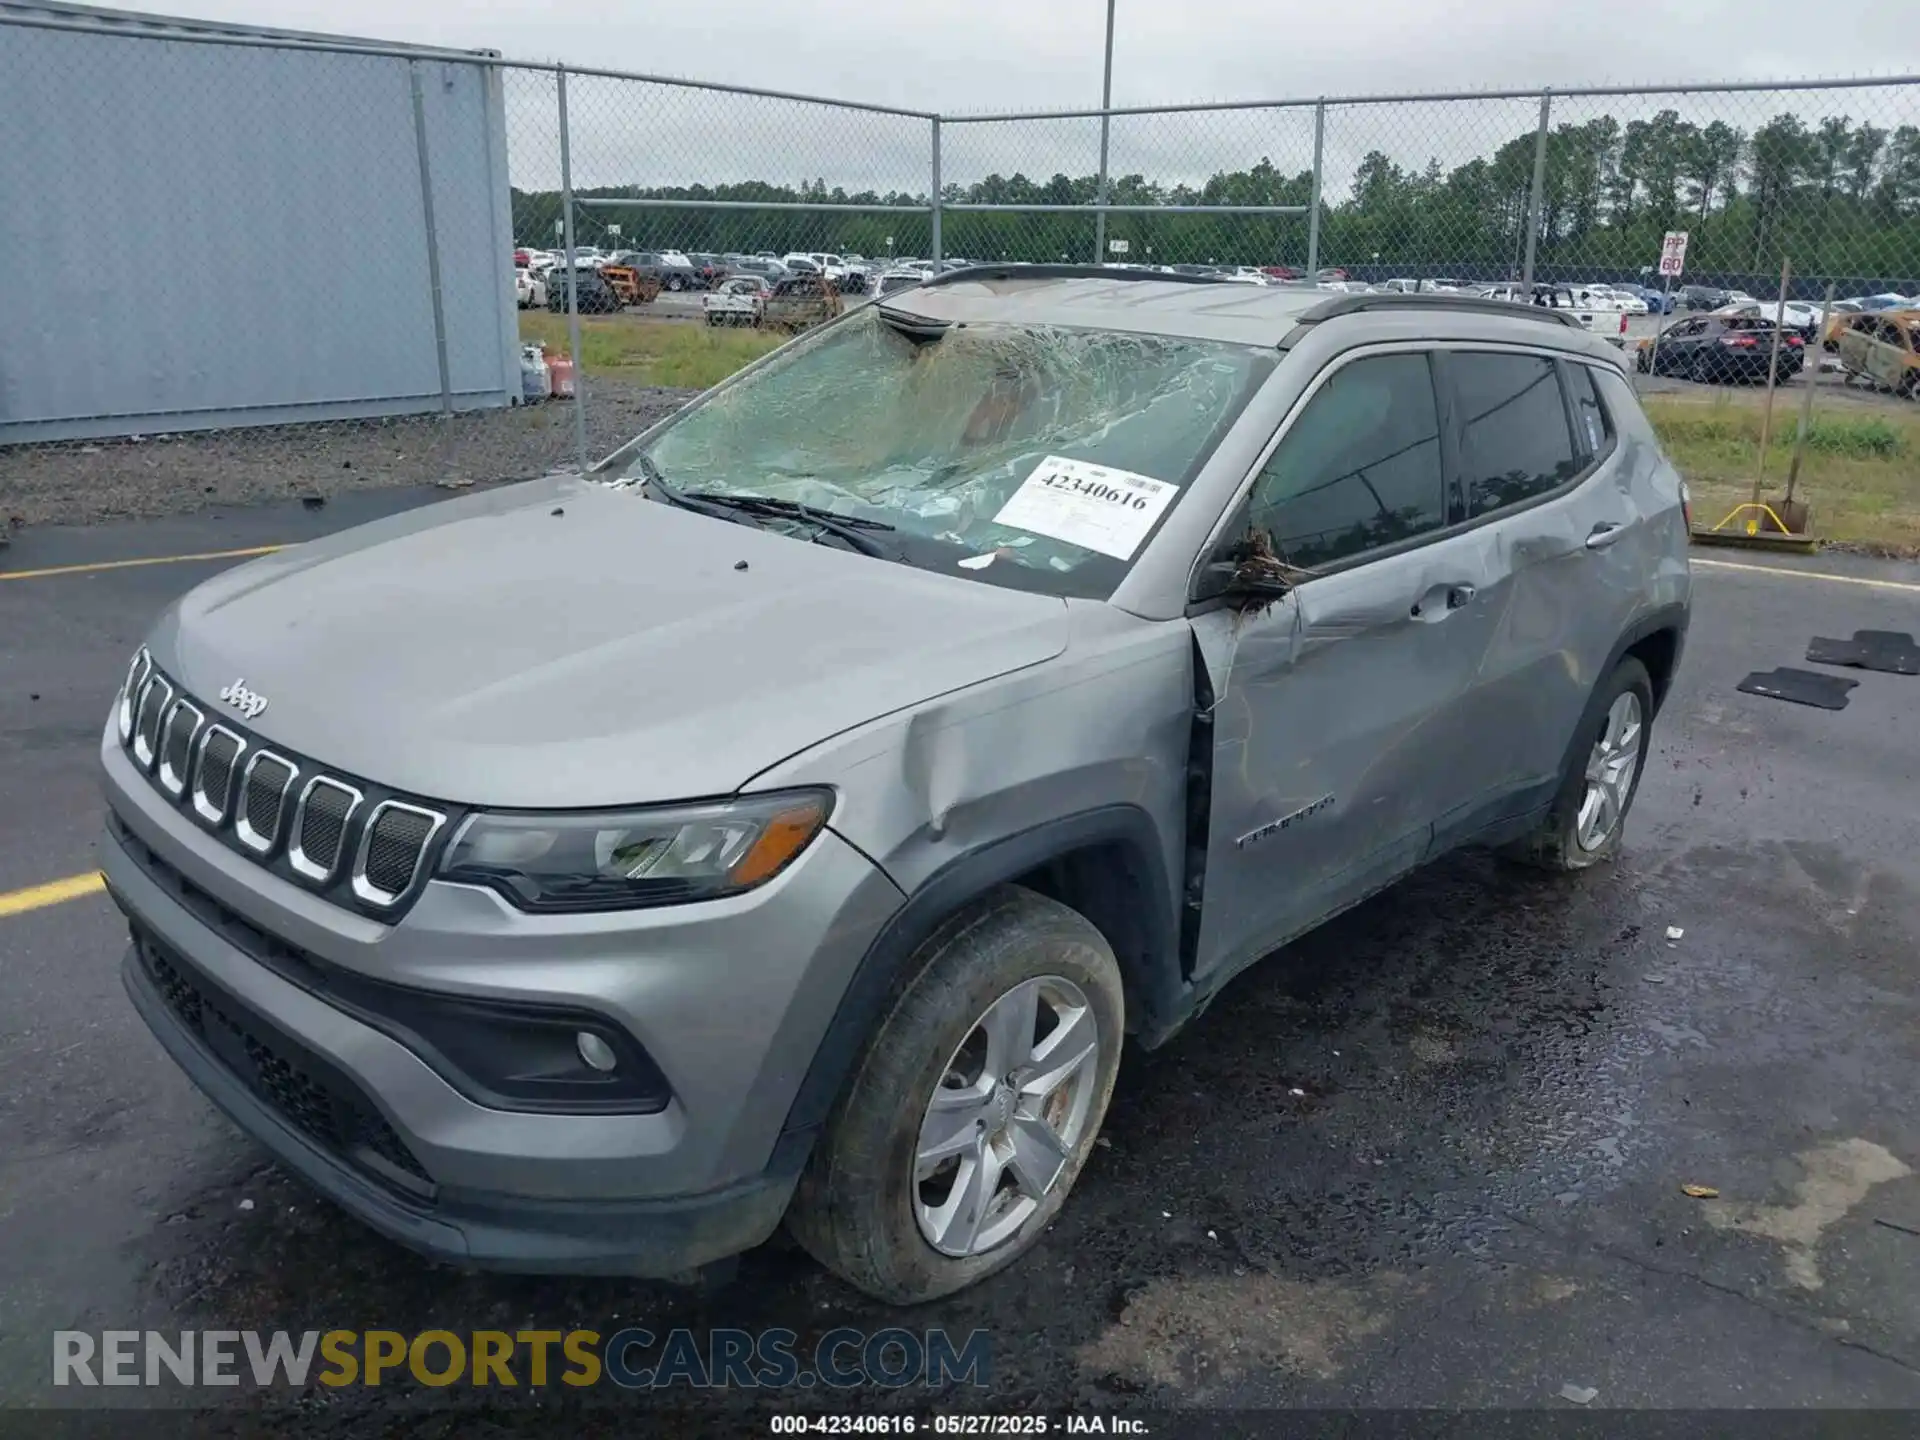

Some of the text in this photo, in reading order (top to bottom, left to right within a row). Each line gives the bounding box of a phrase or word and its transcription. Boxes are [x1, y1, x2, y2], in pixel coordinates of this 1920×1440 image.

[1662, 257, 1681, 270] 60
[1041, 471, 1150, 510] 42340616
[220, 678, 268, 720] Jeep
